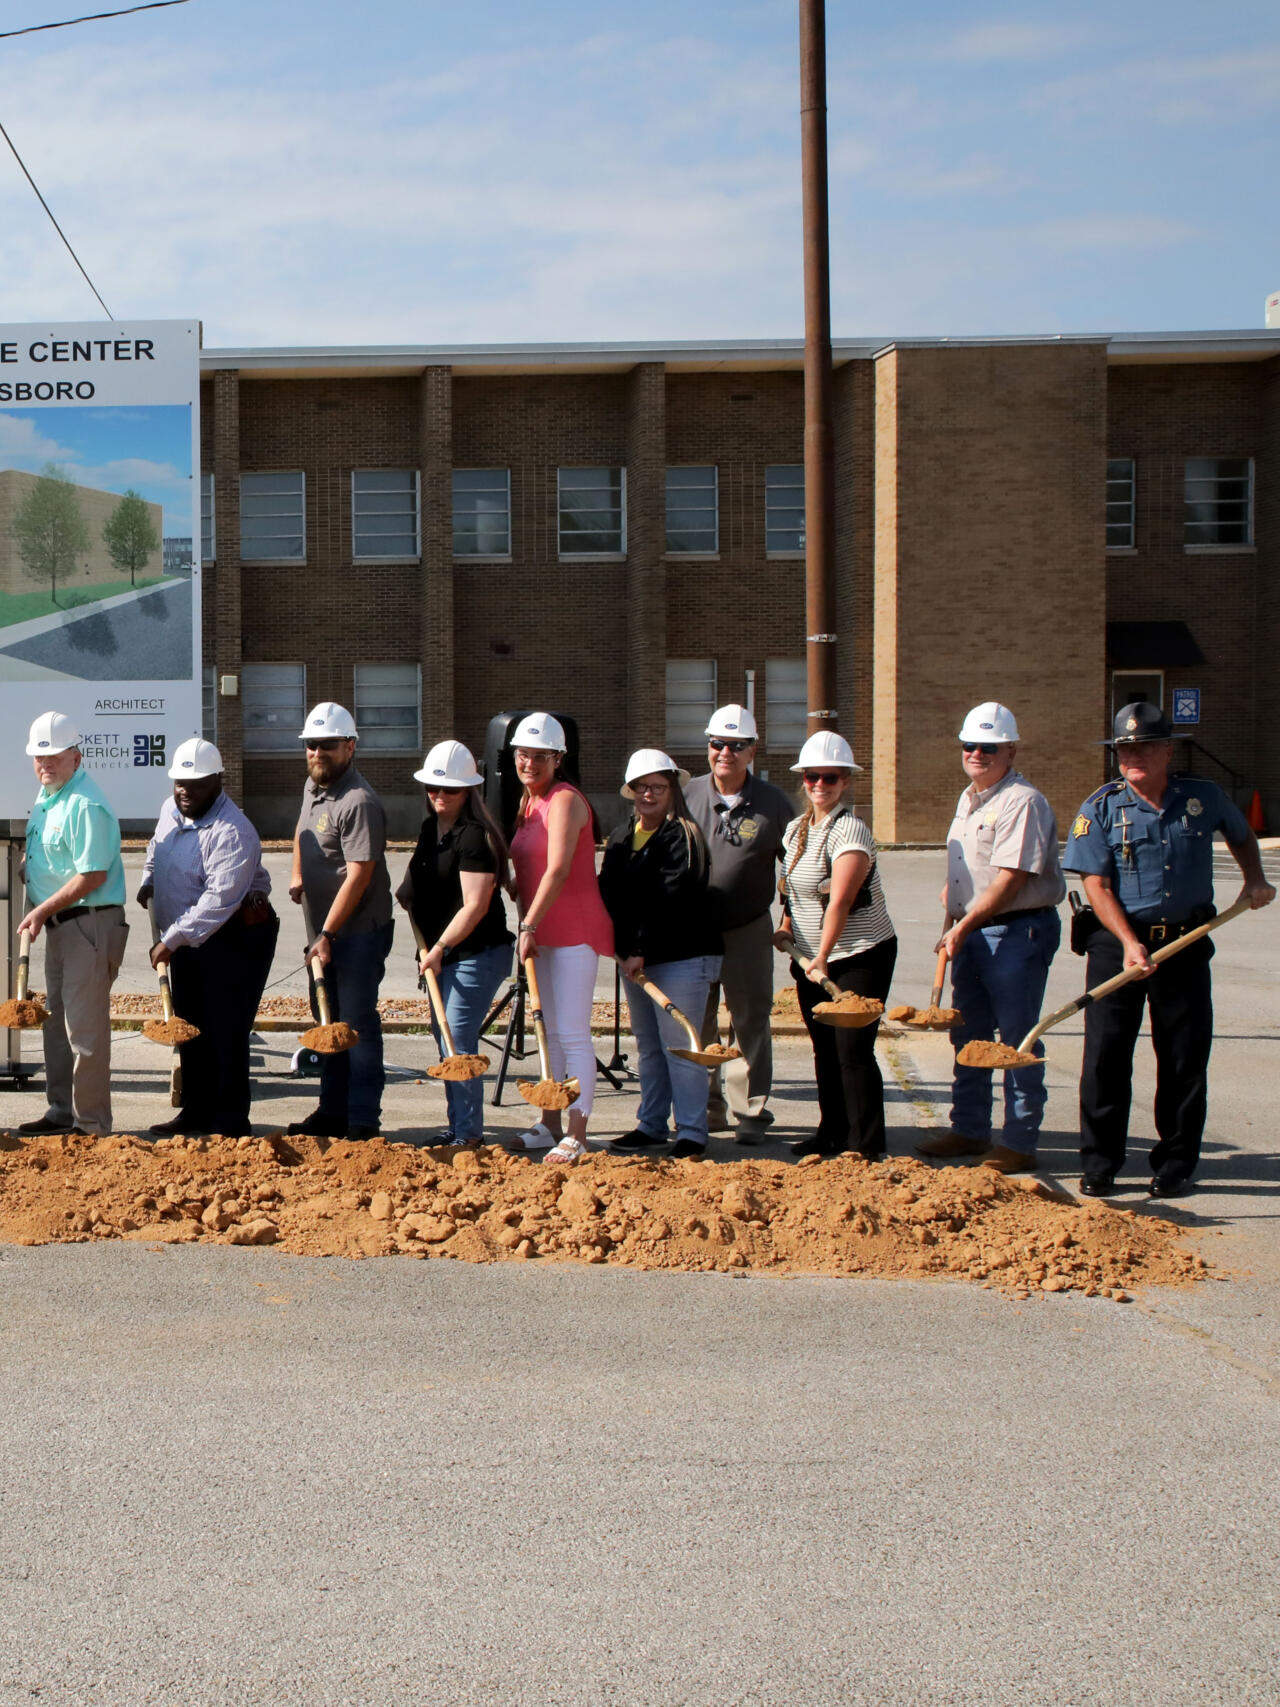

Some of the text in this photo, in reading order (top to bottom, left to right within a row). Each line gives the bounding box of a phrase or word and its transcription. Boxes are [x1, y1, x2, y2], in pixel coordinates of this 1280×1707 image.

[29, 339, 155, 362] CENTER
[95, 699, 165, 710] ARCHITECT
[78, 734, 120, 745] CKETT
